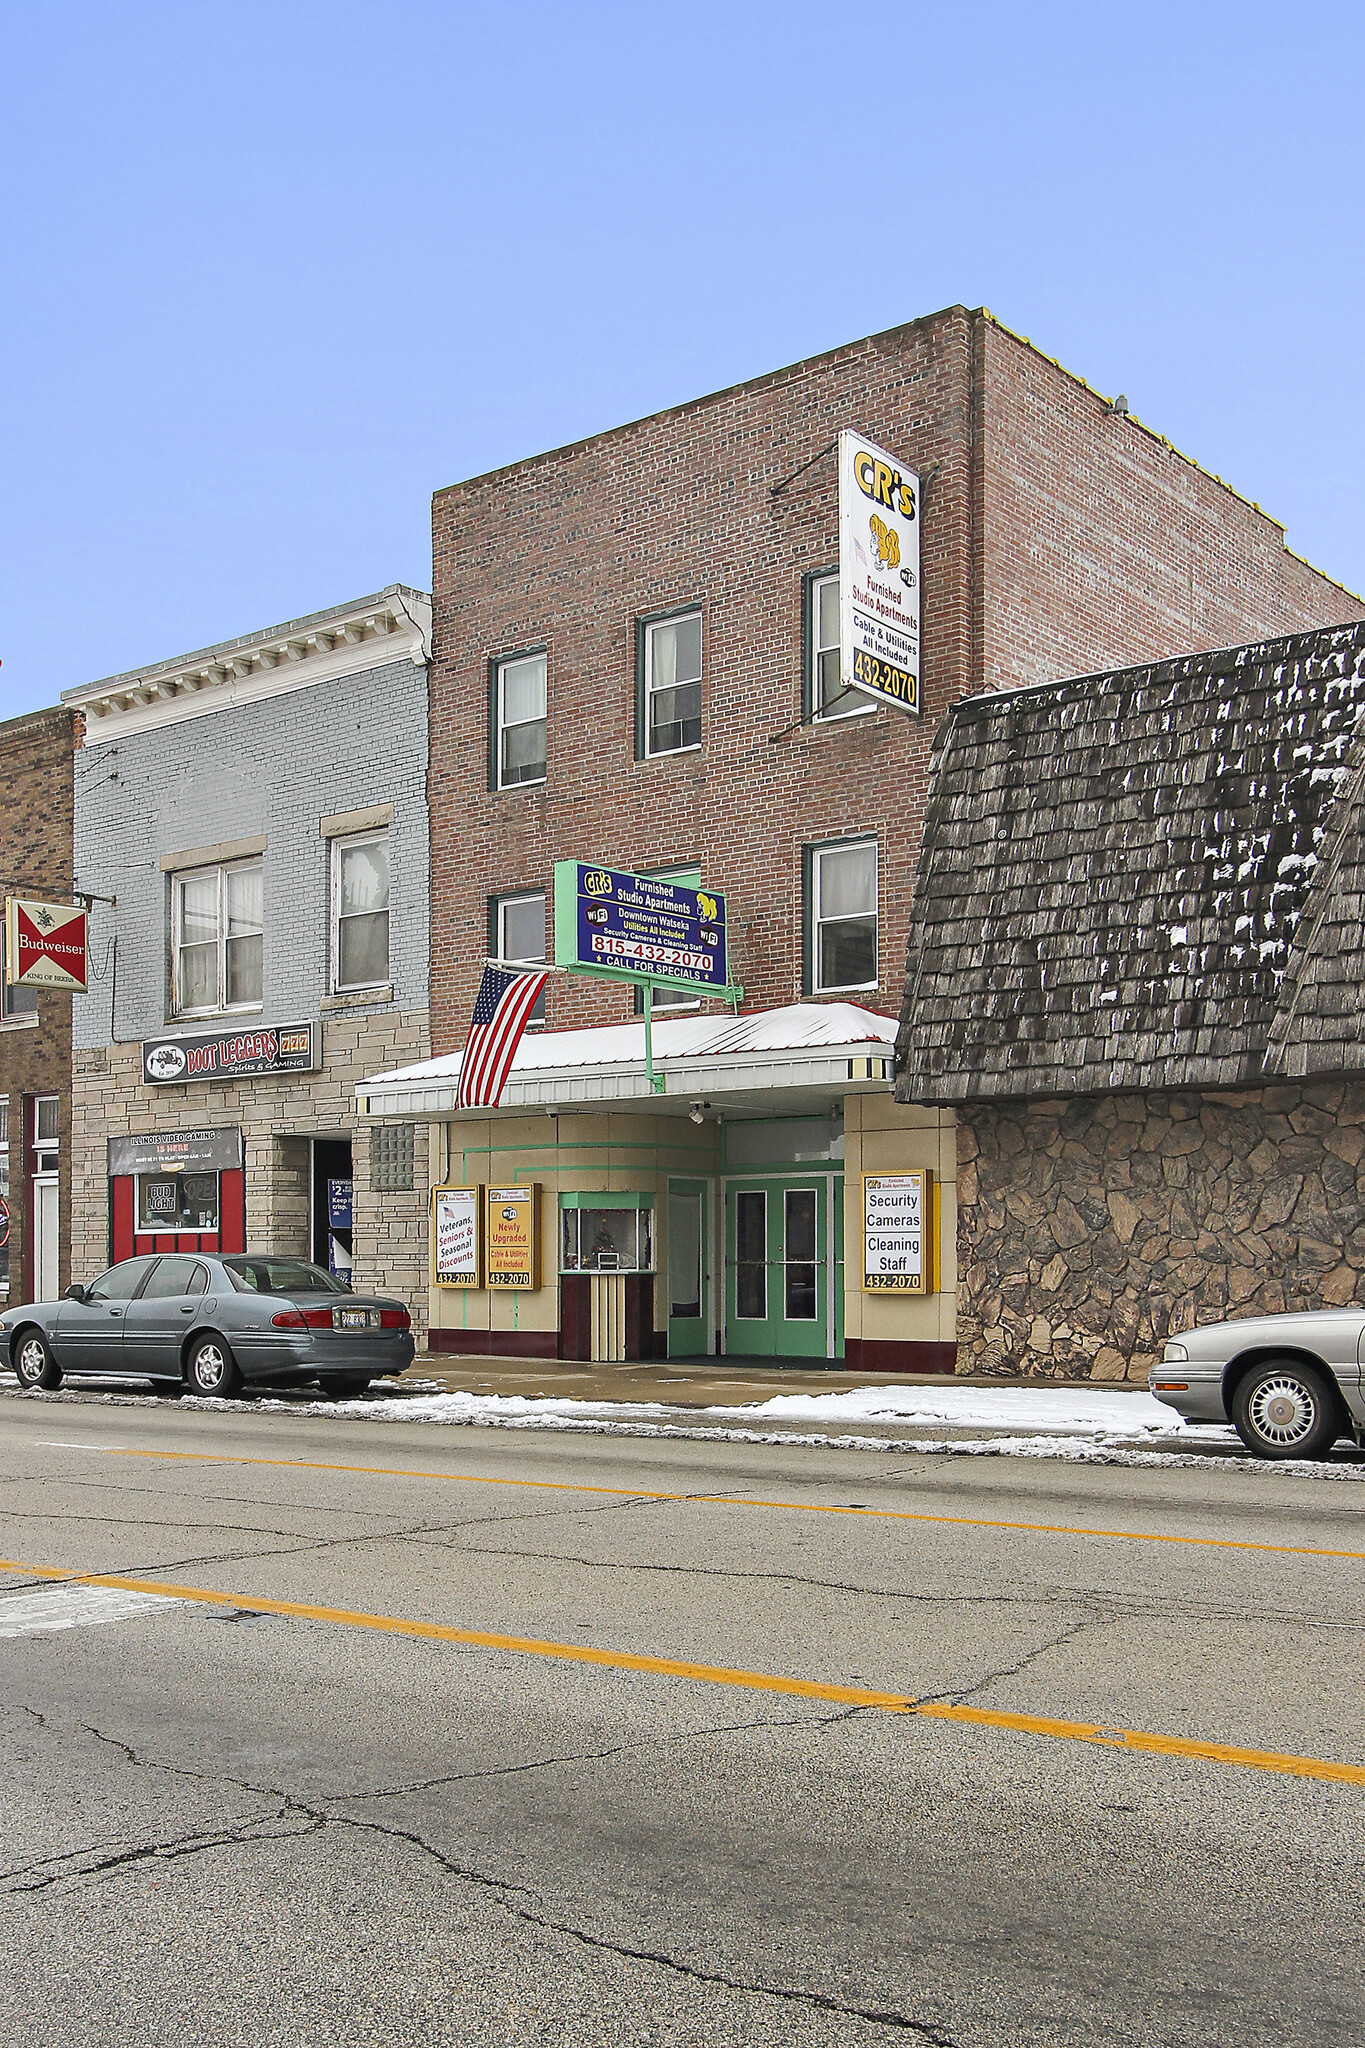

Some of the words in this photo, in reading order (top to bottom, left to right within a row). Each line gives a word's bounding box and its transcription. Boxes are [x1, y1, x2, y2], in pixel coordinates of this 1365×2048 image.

[854, 451, 916, 521] CR's
[867, 575, 902, 605] Furnished
[852, 585, 874, 609] Studio
[876, 598, 918, 631] Apartments
[854, 615, 876, 636] Cable
[878, 628, 884, 640] &
[885, 631, 917, 656] Utilities
[863, 635, 872, 649] All
[875, 640, 908, 666] Included
[855, 651, 916, 704] 432-2070
[584, 870, 613, 896] CR's
[634, 878, 674, 898] Furnished
[617, 889, 644, 906] Studio
[645, 897, 691, 915] Apartments
[618, 907, 658, 926] Downtown
[659, 916, 690, 931] Watseka
[604, 928, 628, 940] Security
[629, 931, 657, 944] Cameras
[664, 938, 688, 950] Cleaning
[623, 920, 649, 934] Utilities
[650, 927, 658, 936] All
[659, 928, 686, 940] Included
[19, 933, 85, 955] Budweiser
[594, 936, 711, 969] 815-432-2070
[606, 955, 632, 970] CALL
[634, 960, 654, 973] FOR
[656, 964, 701, 980] SPECIALS
[187, 1043, 217, 1075] BOOT
[219, 1029, 278, 1067] LEGGERS
[228, 1065, 255, 1074] Spirits
[265, 1060, 304, 1069] GAMING
[131, 1135, 161, 1146] ILLINOIS
[162, 1133, 184, 1143] VIDEO
[186, 1131, 216, 1141] GAMING
[166, 1144, 188, 1152] HERE
[151, 1186, 170, 1198] BUD
[869, 1194, 918, 1209] Security
[148, 1198, 175, 1210] LIGHT
[439, 1216, 473, 1234] Veterans,
[498, 1223, 520, 1232] Newly
[867, 1214, 920, 1227] Cameras
[439, 1231, 465, 1247] Seniors
[466, 1226, 474, 1236] &
[492, 1234, 526, 1244] Upgraded
[868, 1237, 919, 1254] Cleaning
[440, 1238, 472, 1258] Seasonal
[510, 1250, 528, 1258] Utilities
[439, 1251, 474, 1270] Discounts
[879, 1257, 907, 1271] Staff
[438, 1274, 475, 1284] 432-2070
[490, 1274, 528, 1284] 432-2070
[866, 1275, 919, 1288] 432-2070
